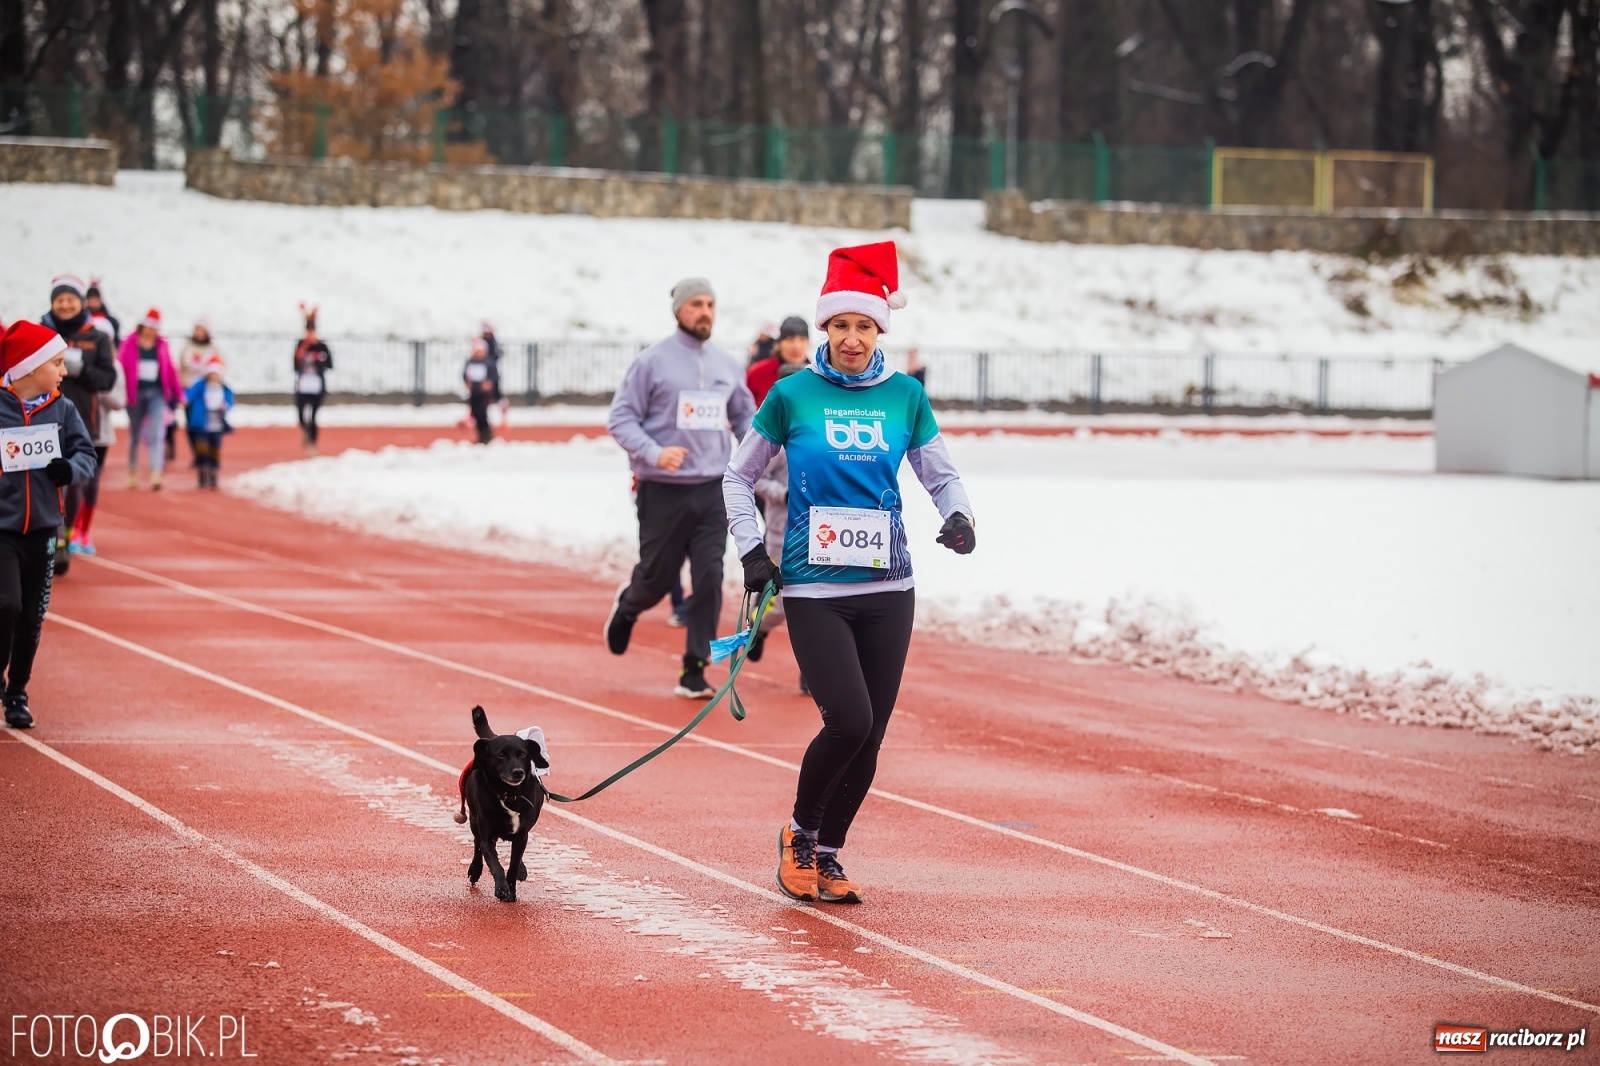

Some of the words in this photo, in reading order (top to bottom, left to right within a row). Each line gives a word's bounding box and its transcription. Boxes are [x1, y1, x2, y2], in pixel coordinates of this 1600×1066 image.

[824, 408, 886, 418] BiegamBoLubię
[825, 419, 889, 452] bbl
[22, 440, 54, 456] 036
[838, 453, 878, 462] RACIBÓRZ
[839, 528, 884, 550] 084
